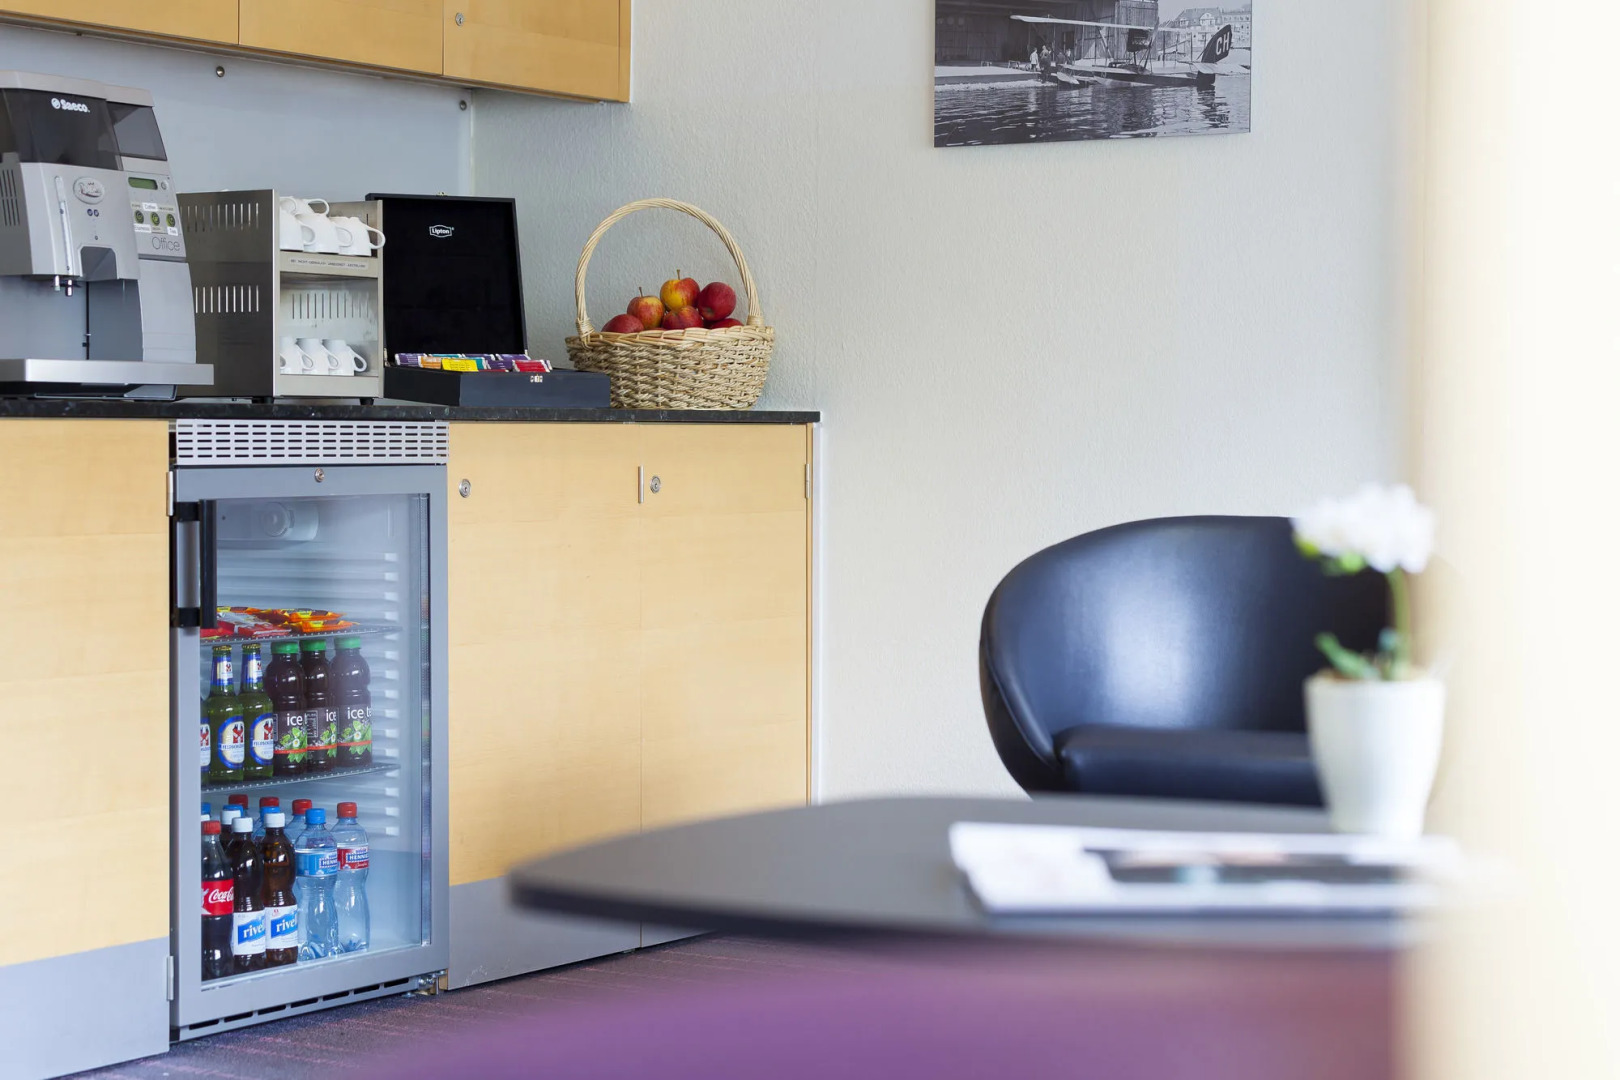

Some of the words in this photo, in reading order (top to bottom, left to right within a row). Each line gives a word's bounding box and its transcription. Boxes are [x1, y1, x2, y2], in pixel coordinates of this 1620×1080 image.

[1216, 31, 1230, 56] CH
[60, 98, 88, 112] Saeco
[431, 227, 450, 235] Lipton
[151, 236, 181, 252] Office
[286, 712, 303, 727] ice
[347, 706, 365, 720] ice
